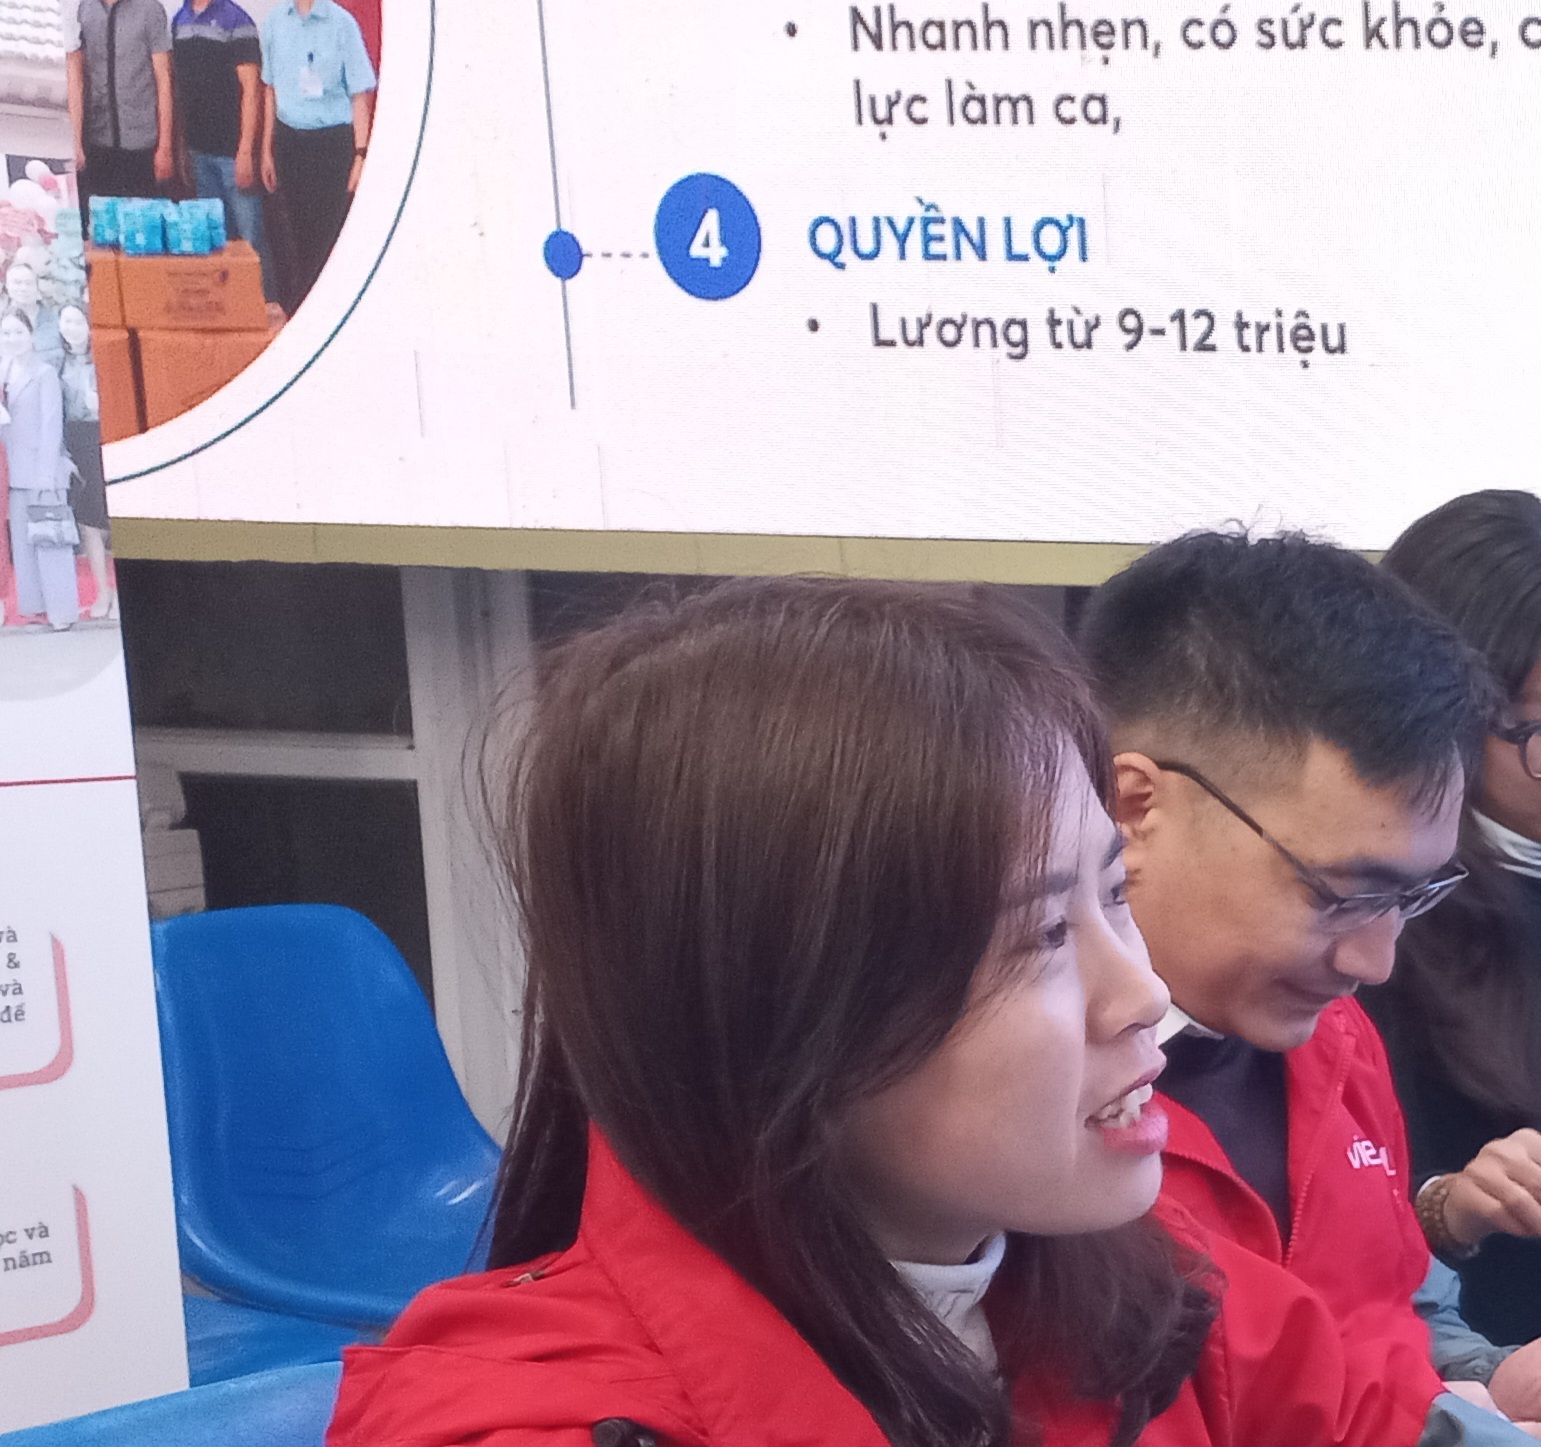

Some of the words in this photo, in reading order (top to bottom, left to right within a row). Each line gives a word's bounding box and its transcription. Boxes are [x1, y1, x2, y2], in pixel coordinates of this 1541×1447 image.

[849, 2, 1009, 52] Nhanh
[1027, 2, 1162, 65] nhẹn,
[1180, 3, 1238, 51] có
[1255, 3, 1345, 51] sức
[853, 78, 929, 141] lực
[945, 78, 1035, 127] làm
[1054, 92, 1122, 135] ca,
[688, 206, 729, 268] 4
[808, 196, 988, 271] QUYỀN
[1004, 213, 1088, 274] LỢI
[869, 302, 1029, 361] Lương
[1047, 305, 1101, 352] từ
[1116, 307, 1218, 353] 9-12
[1233, 308, 1348, 370] triệu
